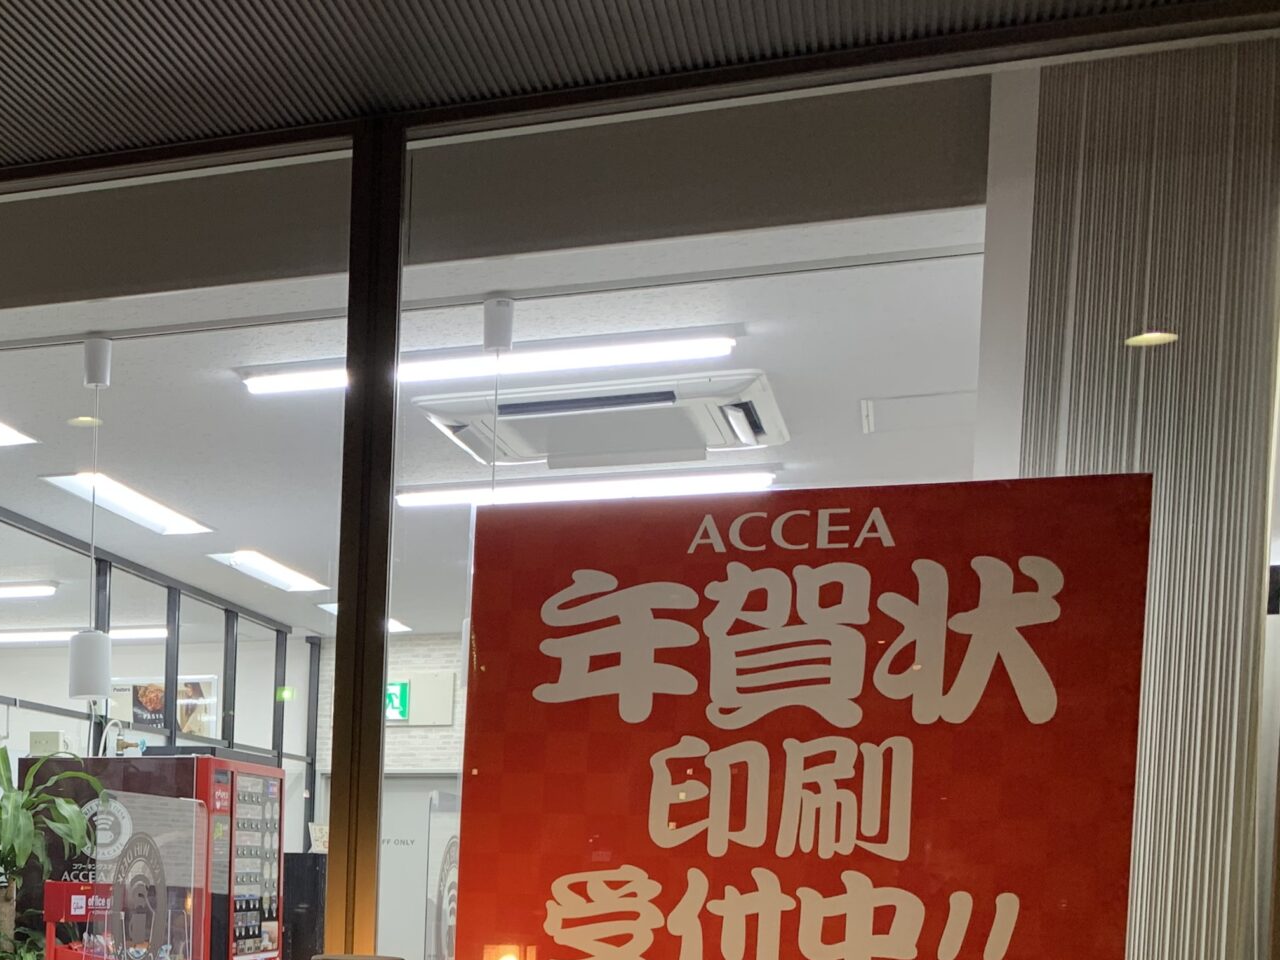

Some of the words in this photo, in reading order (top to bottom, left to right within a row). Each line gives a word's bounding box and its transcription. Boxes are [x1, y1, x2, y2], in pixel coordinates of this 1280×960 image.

[687, 507, 895, 554] ACCEA
[532, 555, 1065, 730] 年賀状
[648, 735, 914, 861] 印刷
